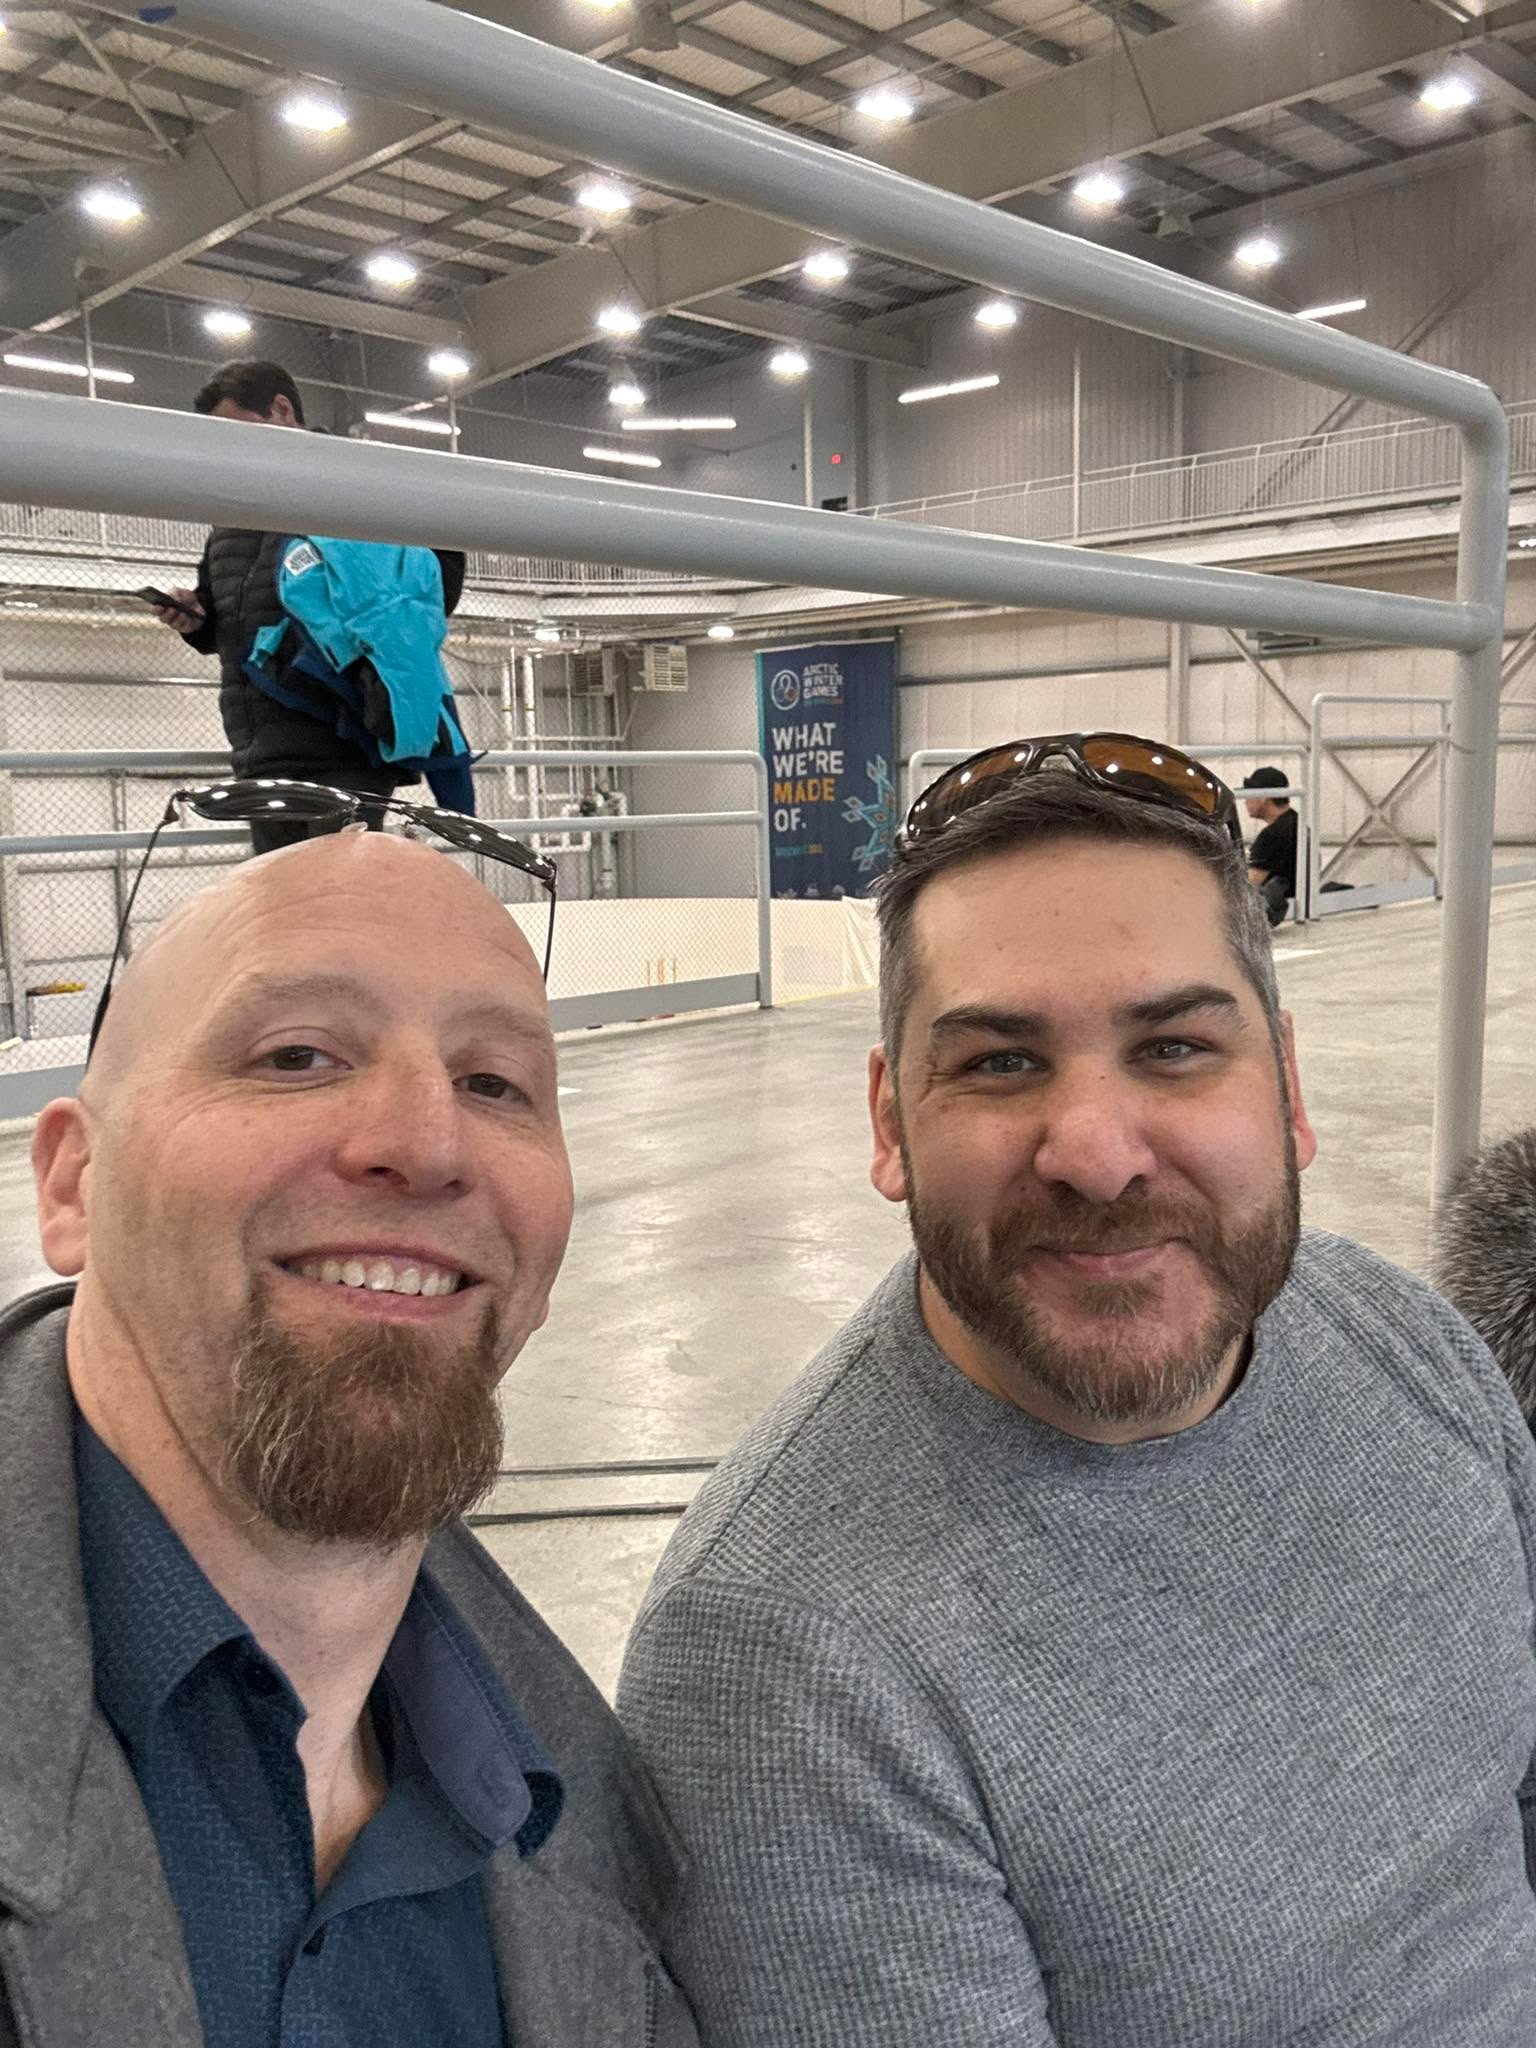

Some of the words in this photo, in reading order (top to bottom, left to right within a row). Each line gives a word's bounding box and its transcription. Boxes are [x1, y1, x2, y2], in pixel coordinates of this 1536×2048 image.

[803, 674, 843, 687] WINTER
[803, 685, 838, 699] GAMES
[772, 722, 836, 751] WHAT
[773, 749, 844, 778] WE'RE
[774, 778, 835, 804] MADE
[774, 807, 807, 832] OF.
